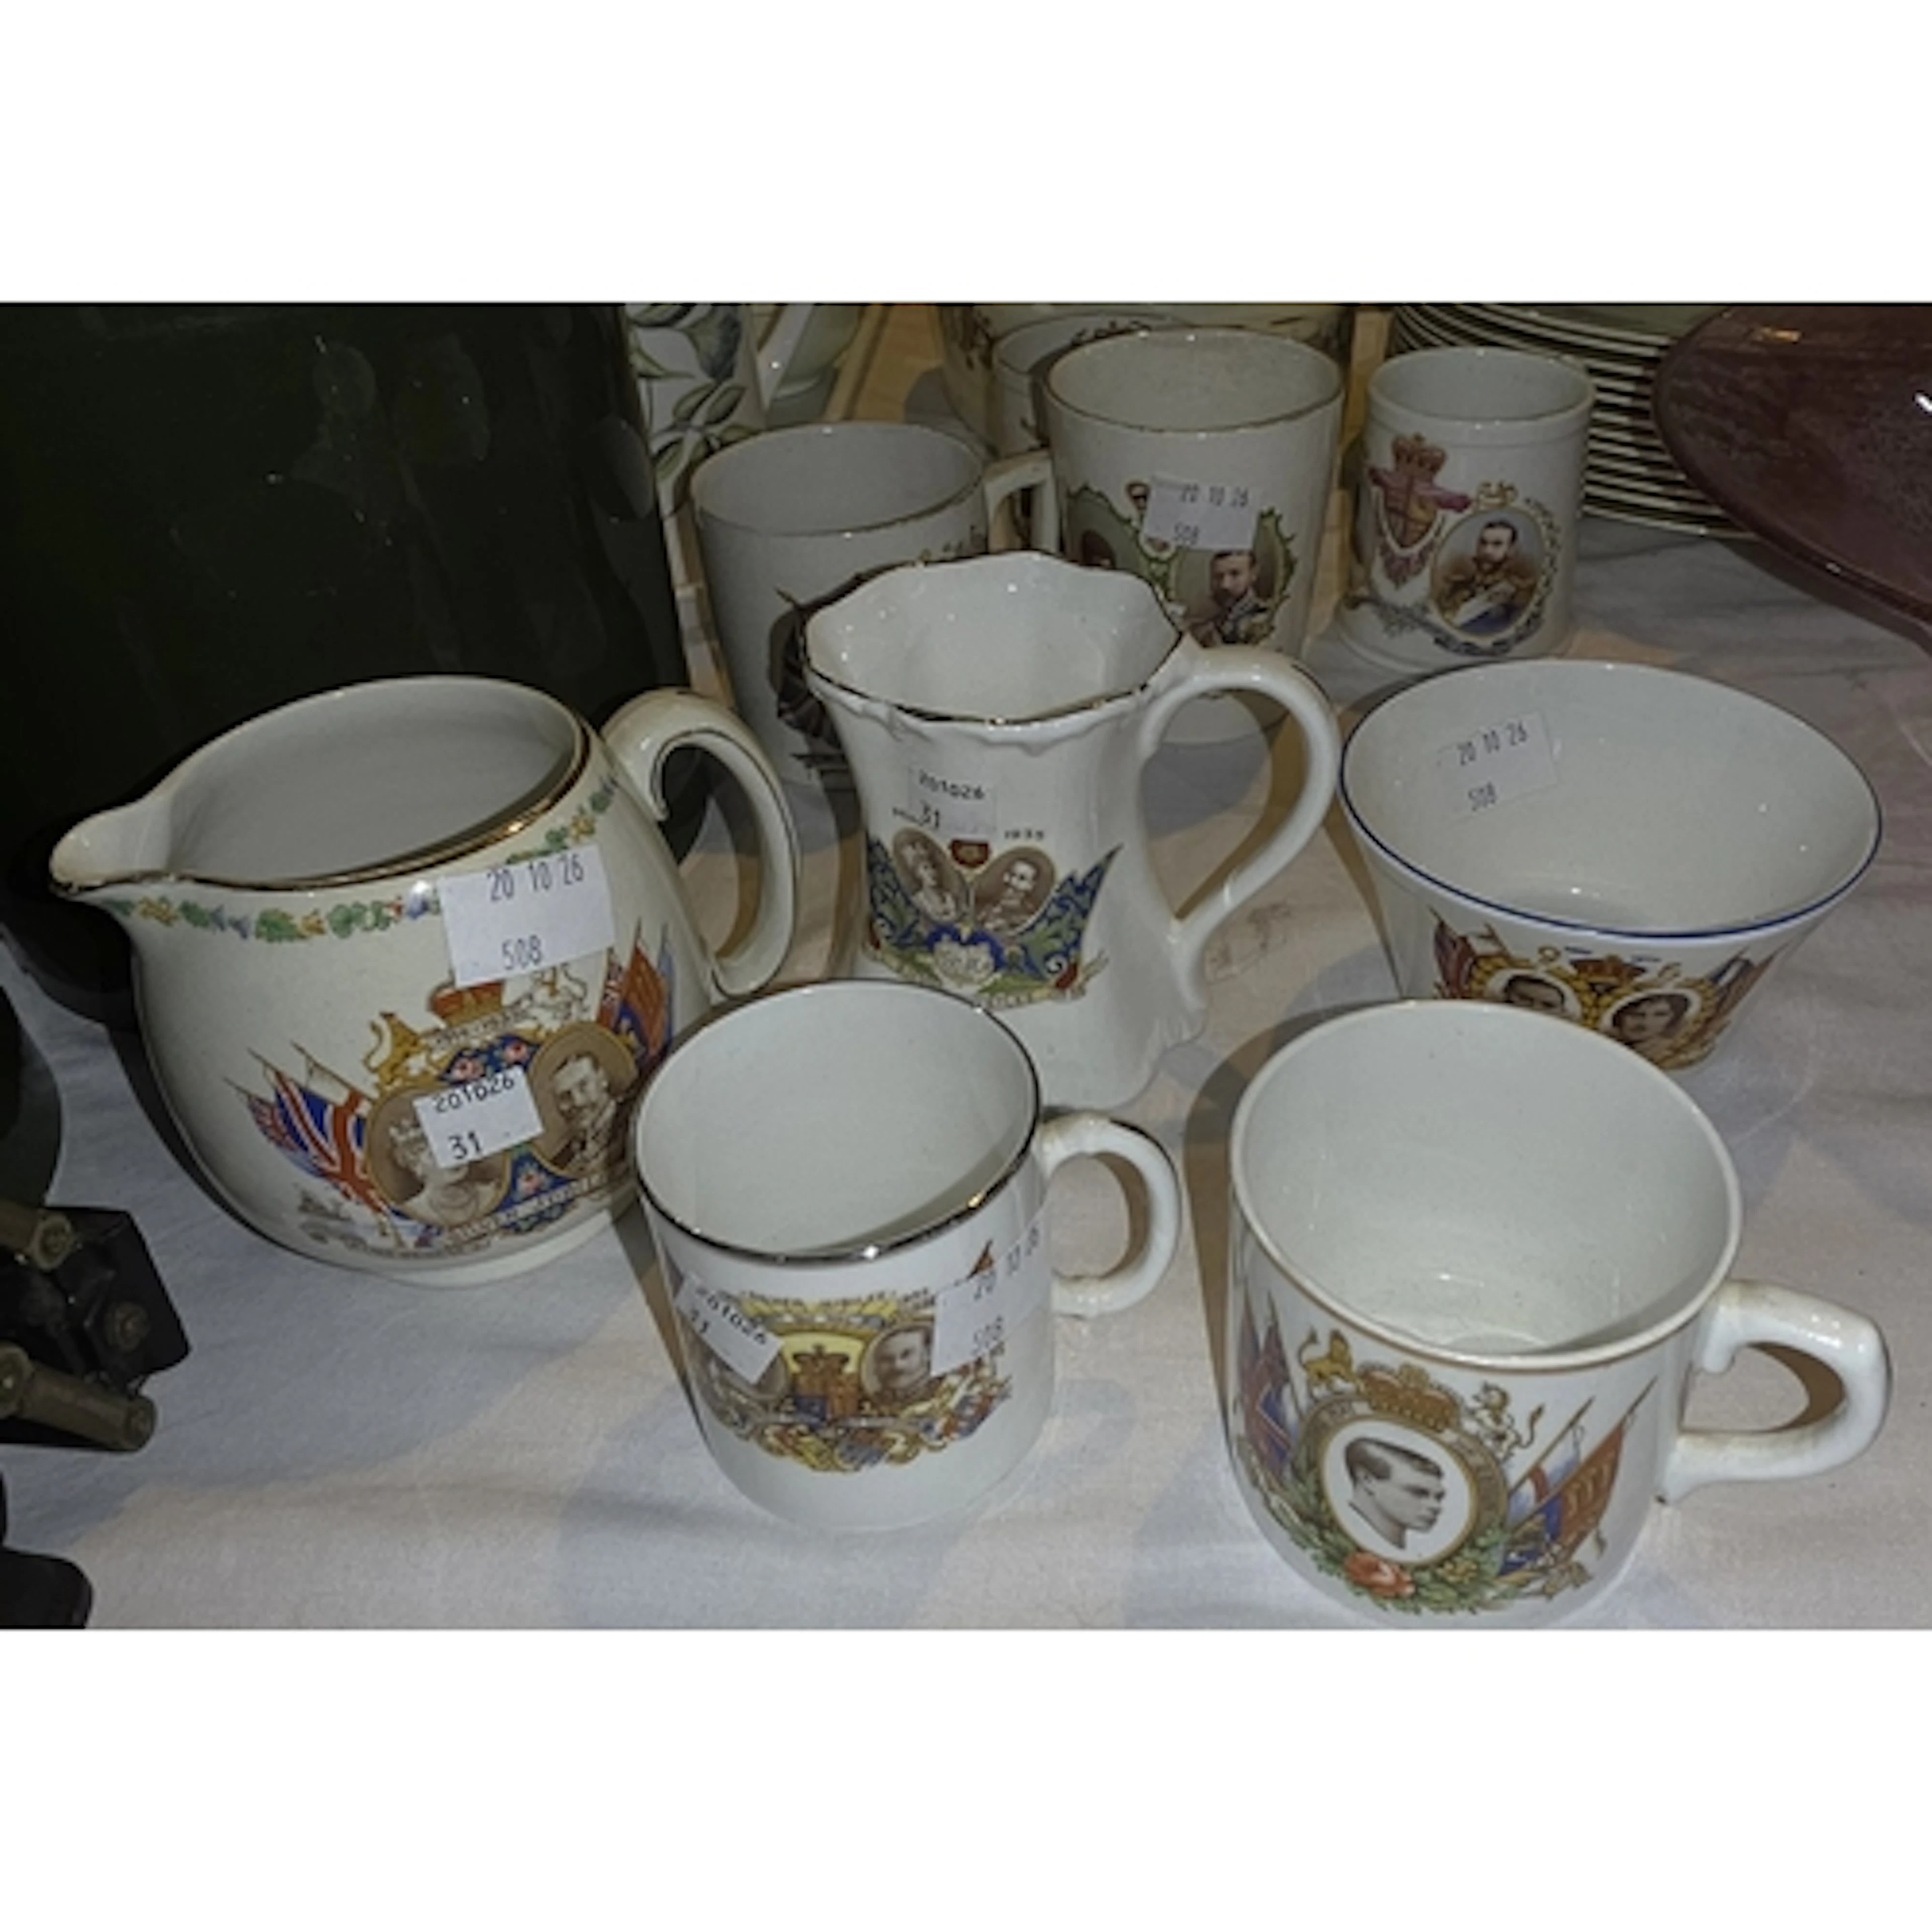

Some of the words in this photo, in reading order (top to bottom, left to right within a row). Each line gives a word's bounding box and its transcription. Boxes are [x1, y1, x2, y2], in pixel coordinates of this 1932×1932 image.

[1457, 741, 1476, 766] 20
[487, 867, 514, 901] 20
[528, 861, 552, 893] 10
[558, 853, 585, 886] 26
[502, 934, 543, 971] 508
[431, 1077, 515, 1113] 201026
[447, 1131, 480, 1159] 31
